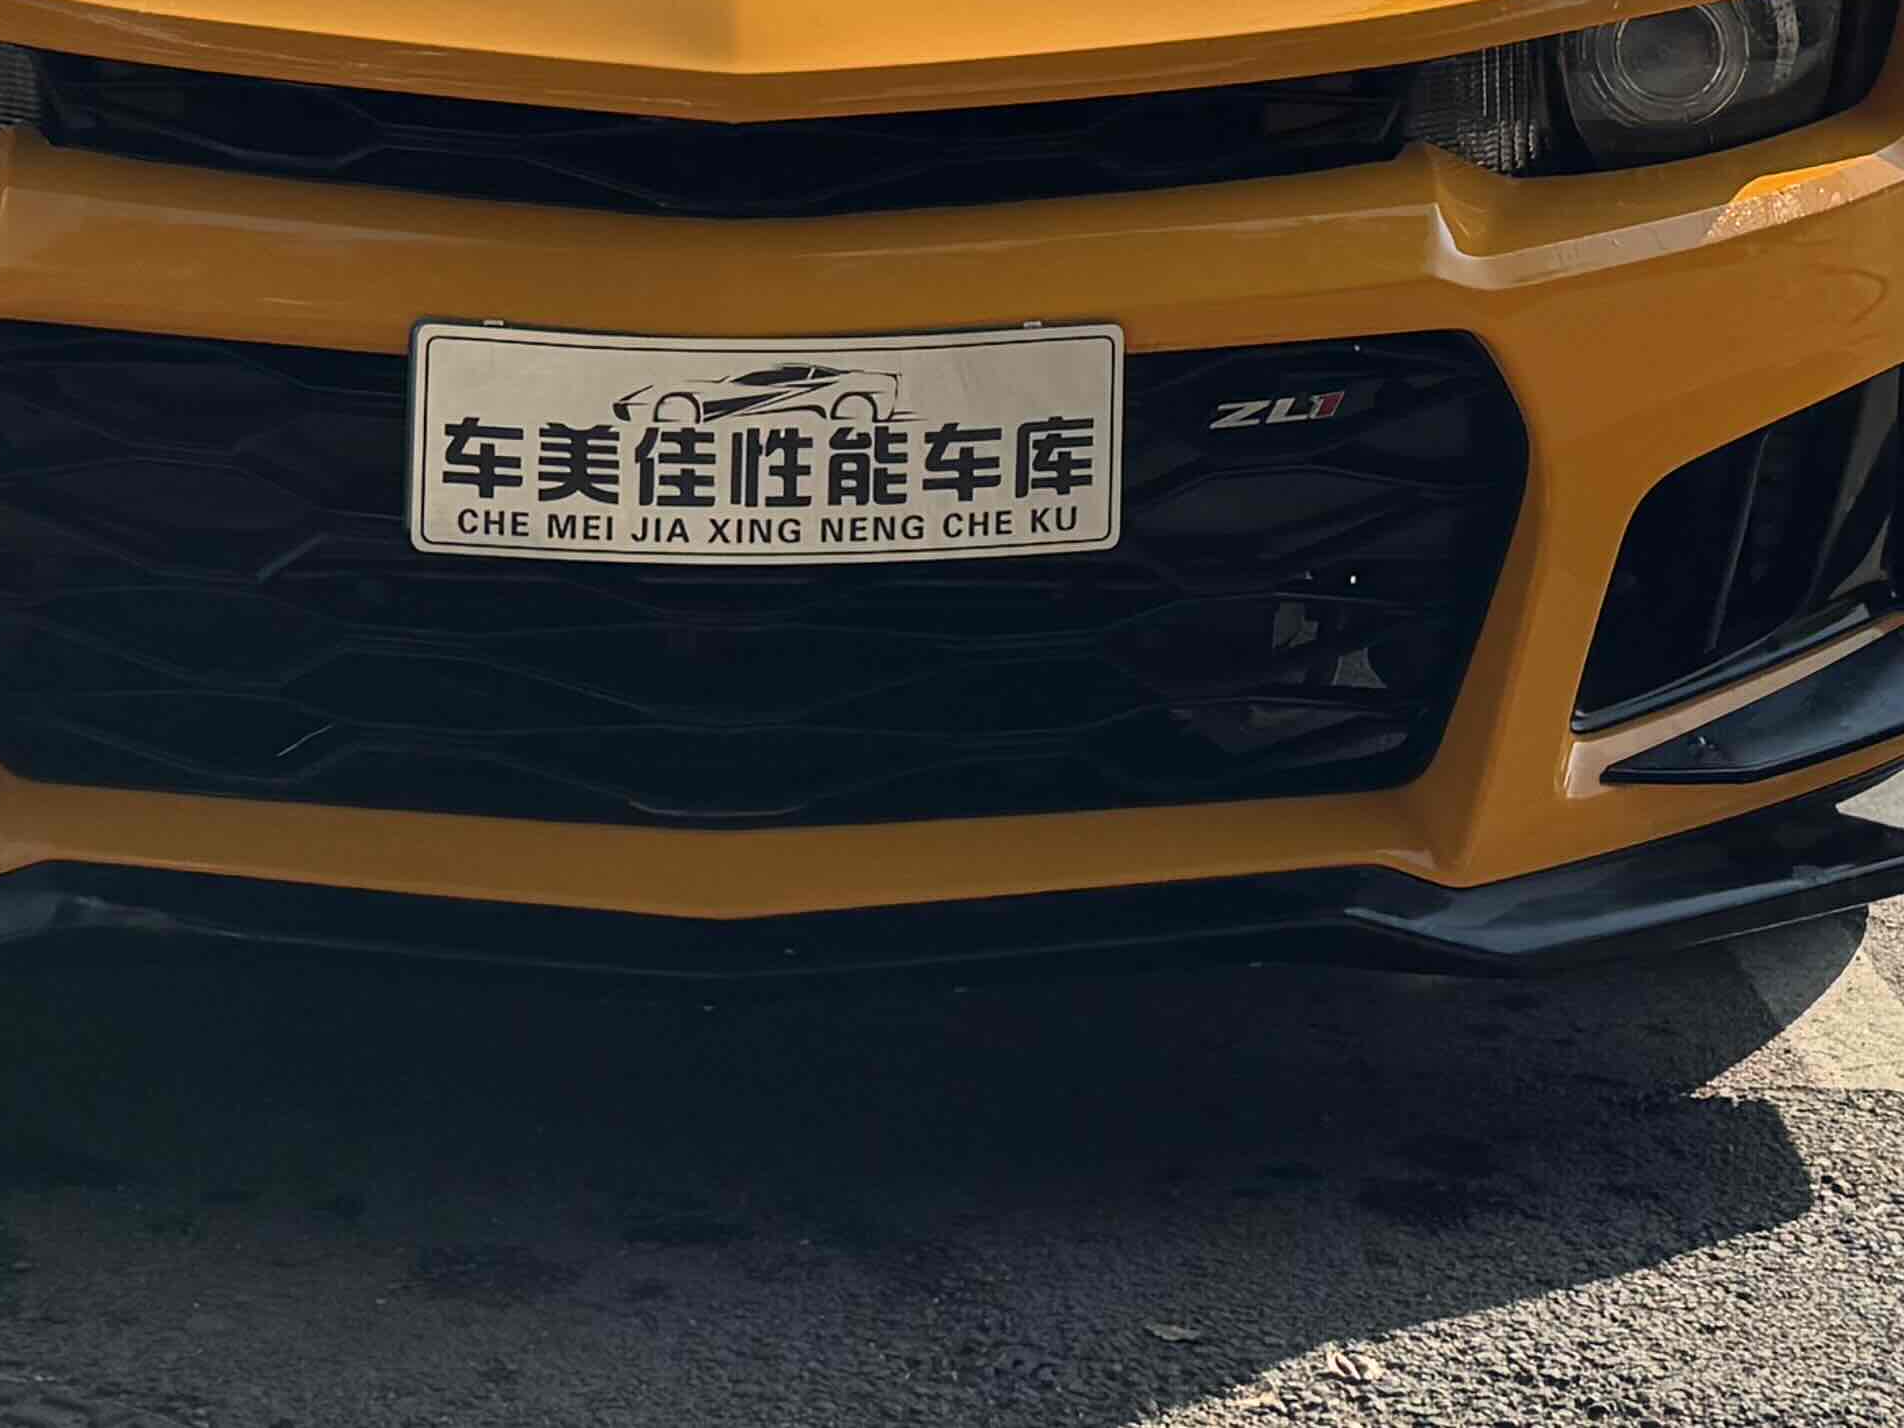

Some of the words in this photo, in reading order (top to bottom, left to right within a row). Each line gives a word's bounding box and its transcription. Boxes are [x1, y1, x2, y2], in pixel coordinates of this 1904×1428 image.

[1209, 391, 1346, 430] ZL1
[442, 415, 1095, 507] 车美佳性能车库
[456, 507, 530, 537] CHE
[547, 513, 614, 542] MEI
[630, 516, 690, 543] JIA
[707, 517, 802, 544] XING
[820, 515, 925, 543] NENG
[942, 509, 1013, 538] CHE
[1030, 505, 1078, 534] KU
